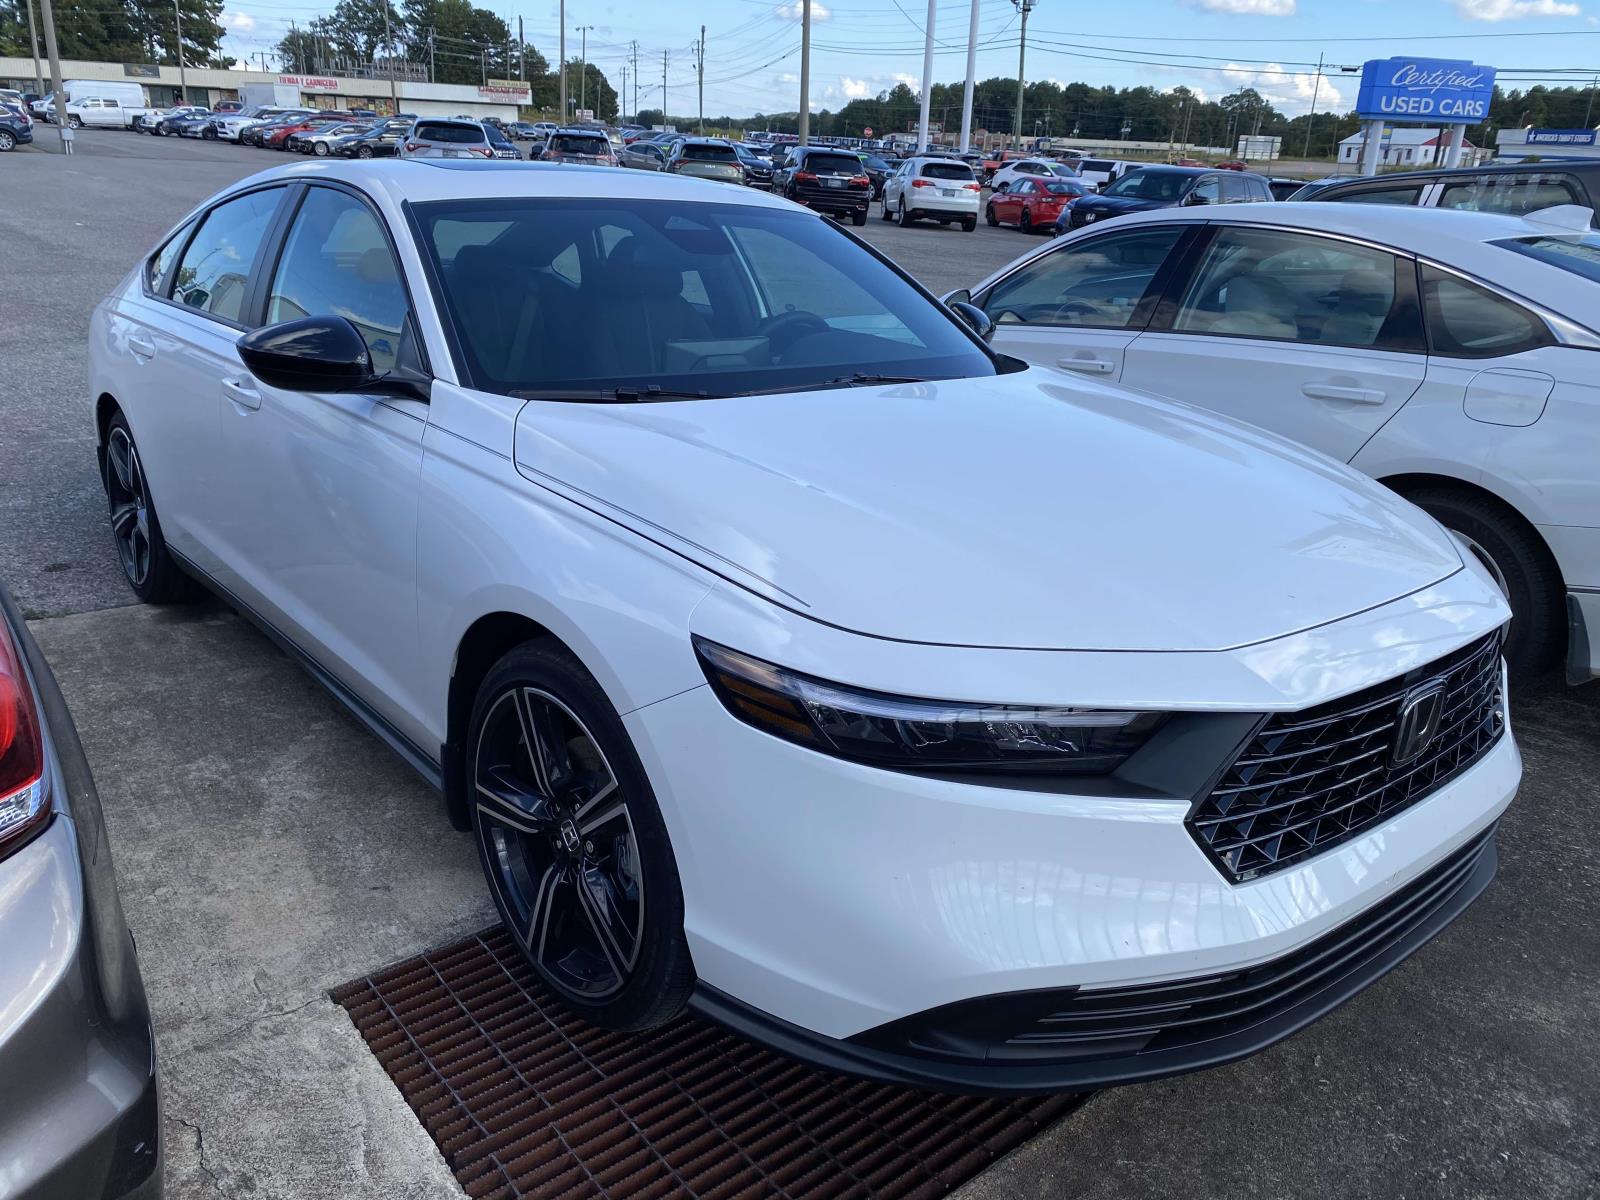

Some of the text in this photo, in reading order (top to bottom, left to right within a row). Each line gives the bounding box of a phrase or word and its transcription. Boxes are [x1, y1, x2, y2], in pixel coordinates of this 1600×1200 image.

[1391, 64, 1484, 94] Certified
[1380, 95, 1485, 116] USED CARS
